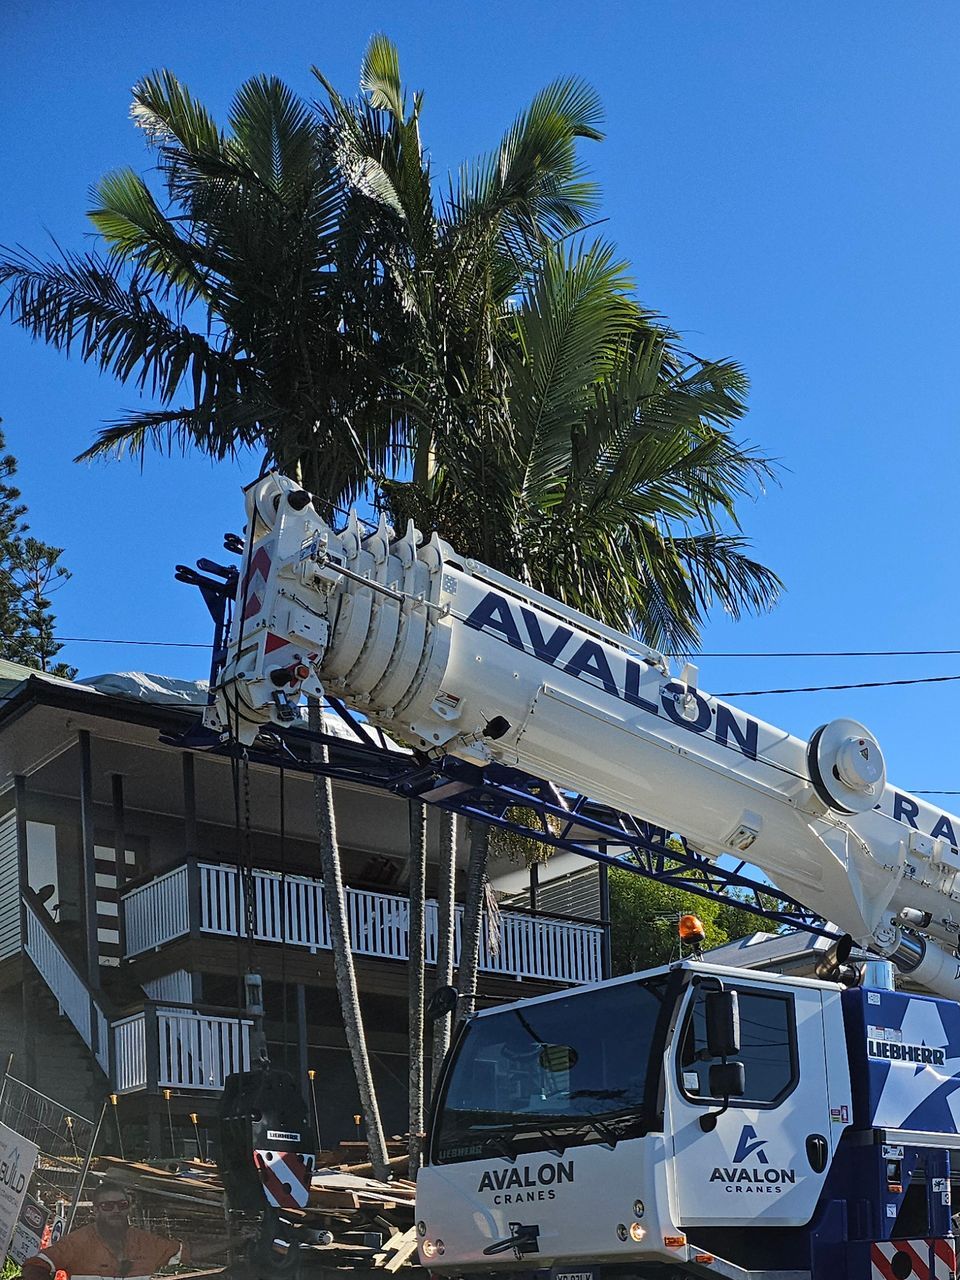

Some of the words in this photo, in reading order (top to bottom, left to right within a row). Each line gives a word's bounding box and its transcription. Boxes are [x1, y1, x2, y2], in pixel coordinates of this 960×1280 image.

[463, 591, 759, 761] AVALON
[868, 1040, 945, 1066] LIEBHERR
[478, 1161, 574, 1192] AVALON
[709, 1168, 796, 1183] AVALON
[494, 1190, 556, 1205] CRANES
[725, 1185, 782, 1193] CRANES
